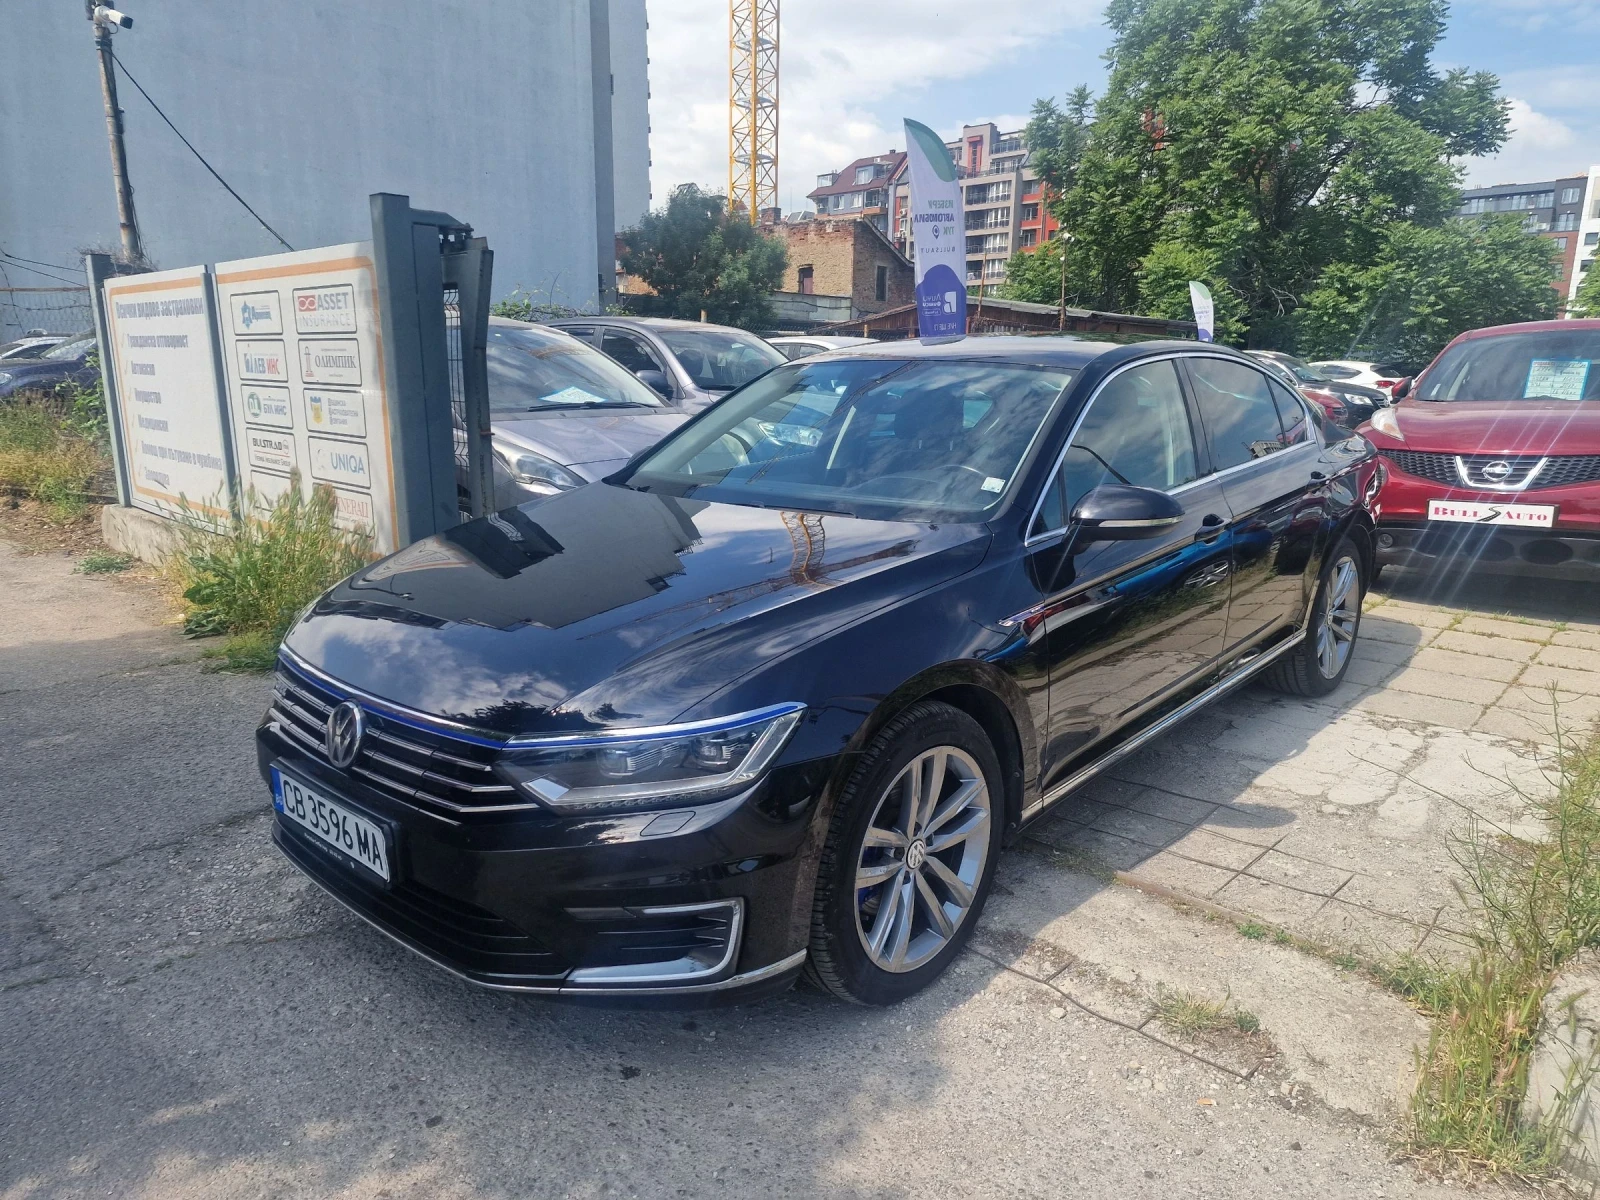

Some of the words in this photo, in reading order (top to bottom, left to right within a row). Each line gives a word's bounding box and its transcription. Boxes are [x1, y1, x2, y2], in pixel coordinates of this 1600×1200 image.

[317, 292, 349, 311] ASSET
[299, 312, 352, 328] INSURANCE
[253, 357, 266, 374] ЛЕВ
[266, 358, 281, 375] ИНС
[314, 355, 357, 369] ОЛИМПИК
[330, 452, 366, 475] UNIQA
[335, 496, 369, 518] ENERALI
